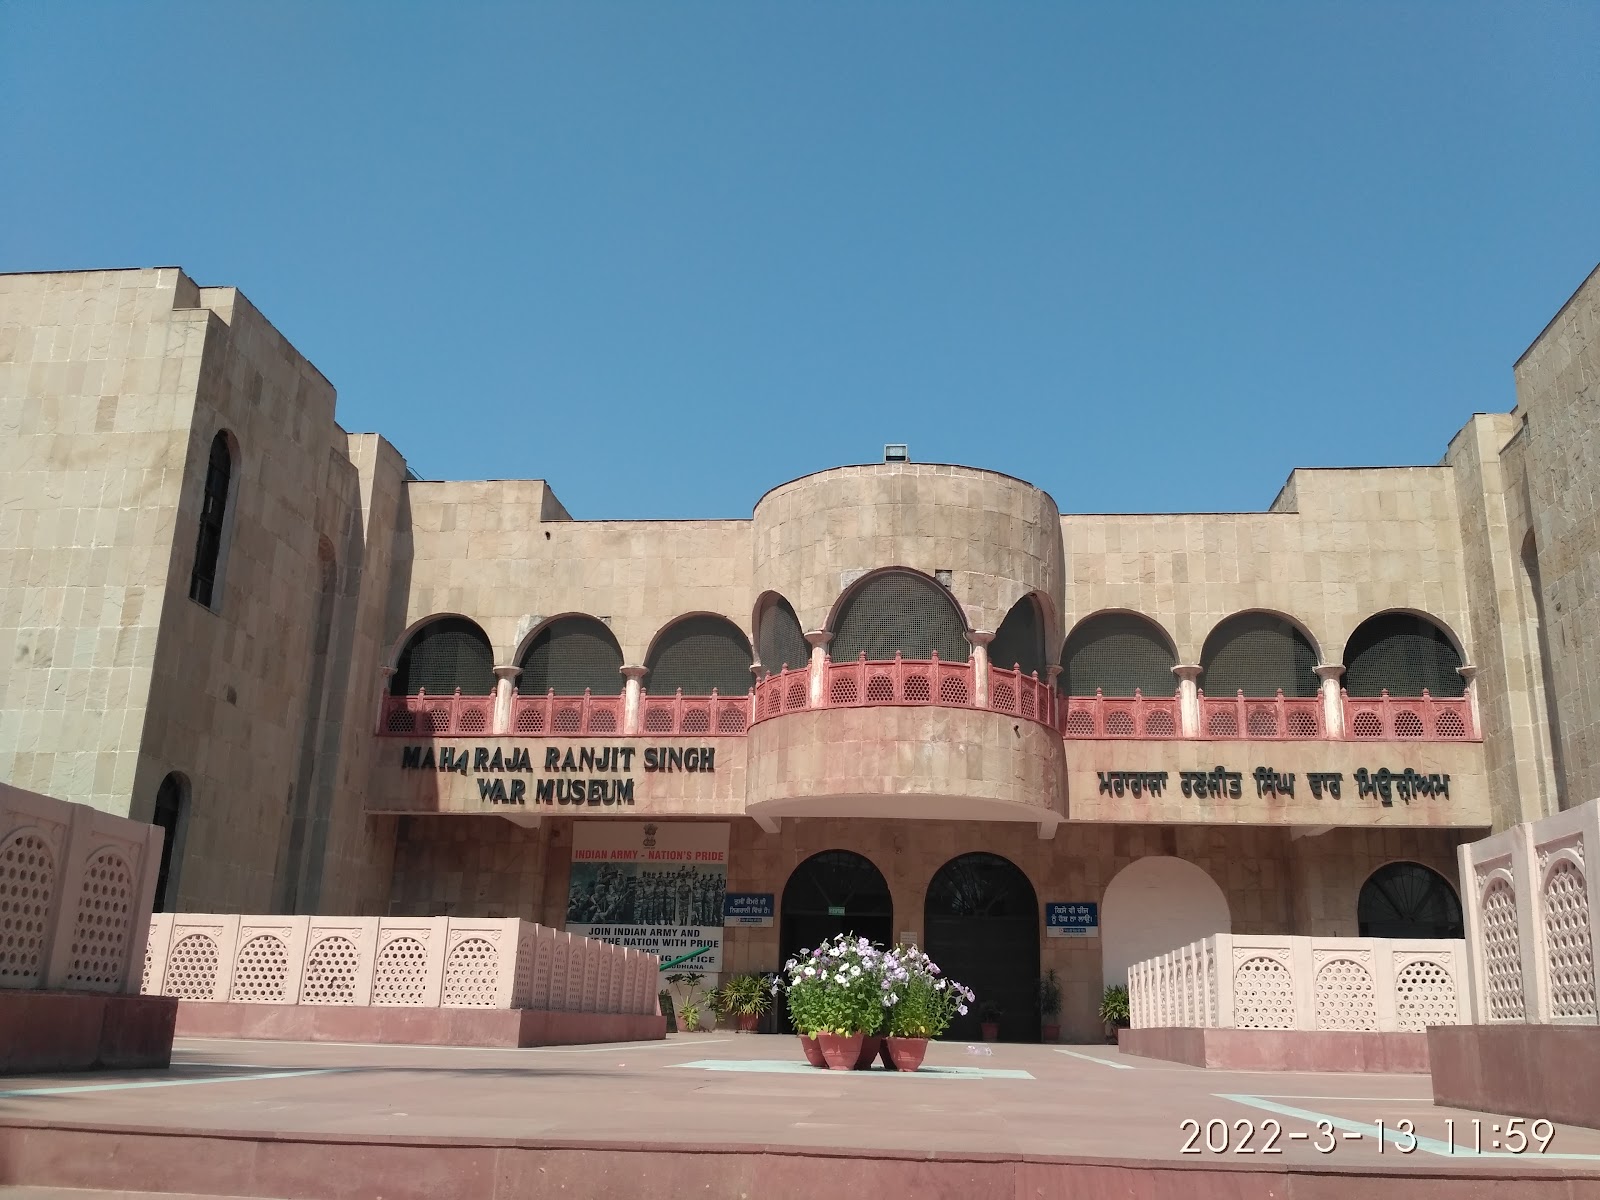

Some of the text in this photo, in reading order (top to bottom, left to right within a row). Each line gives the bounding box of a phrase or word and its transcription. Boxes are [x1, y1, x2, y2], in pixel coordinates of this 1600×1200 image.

[402, 746, 715, 775] MAHARAJA RANJIT SINGH
[477, 778, 634, 806] WAR MUSEUM
[1179, 766, 1242, 799] ਰਣਜੀਤ
[1253, 766, 1296, 799] ਸਿੰਘ
[1306, 772, 1342, 799] ਵਾਰ
[575, 850, 607, 859] INDIAN
[610, 850, 638, 859] ARMY
[648, 850, 691, 860] NATION'S
[695, 851, 724, 861] PRIDE
[589, 927, 700, 938] JOIN INDIAN ARMY AND
[603, 937, 719, 948] THE NATION WITH PRIDE
